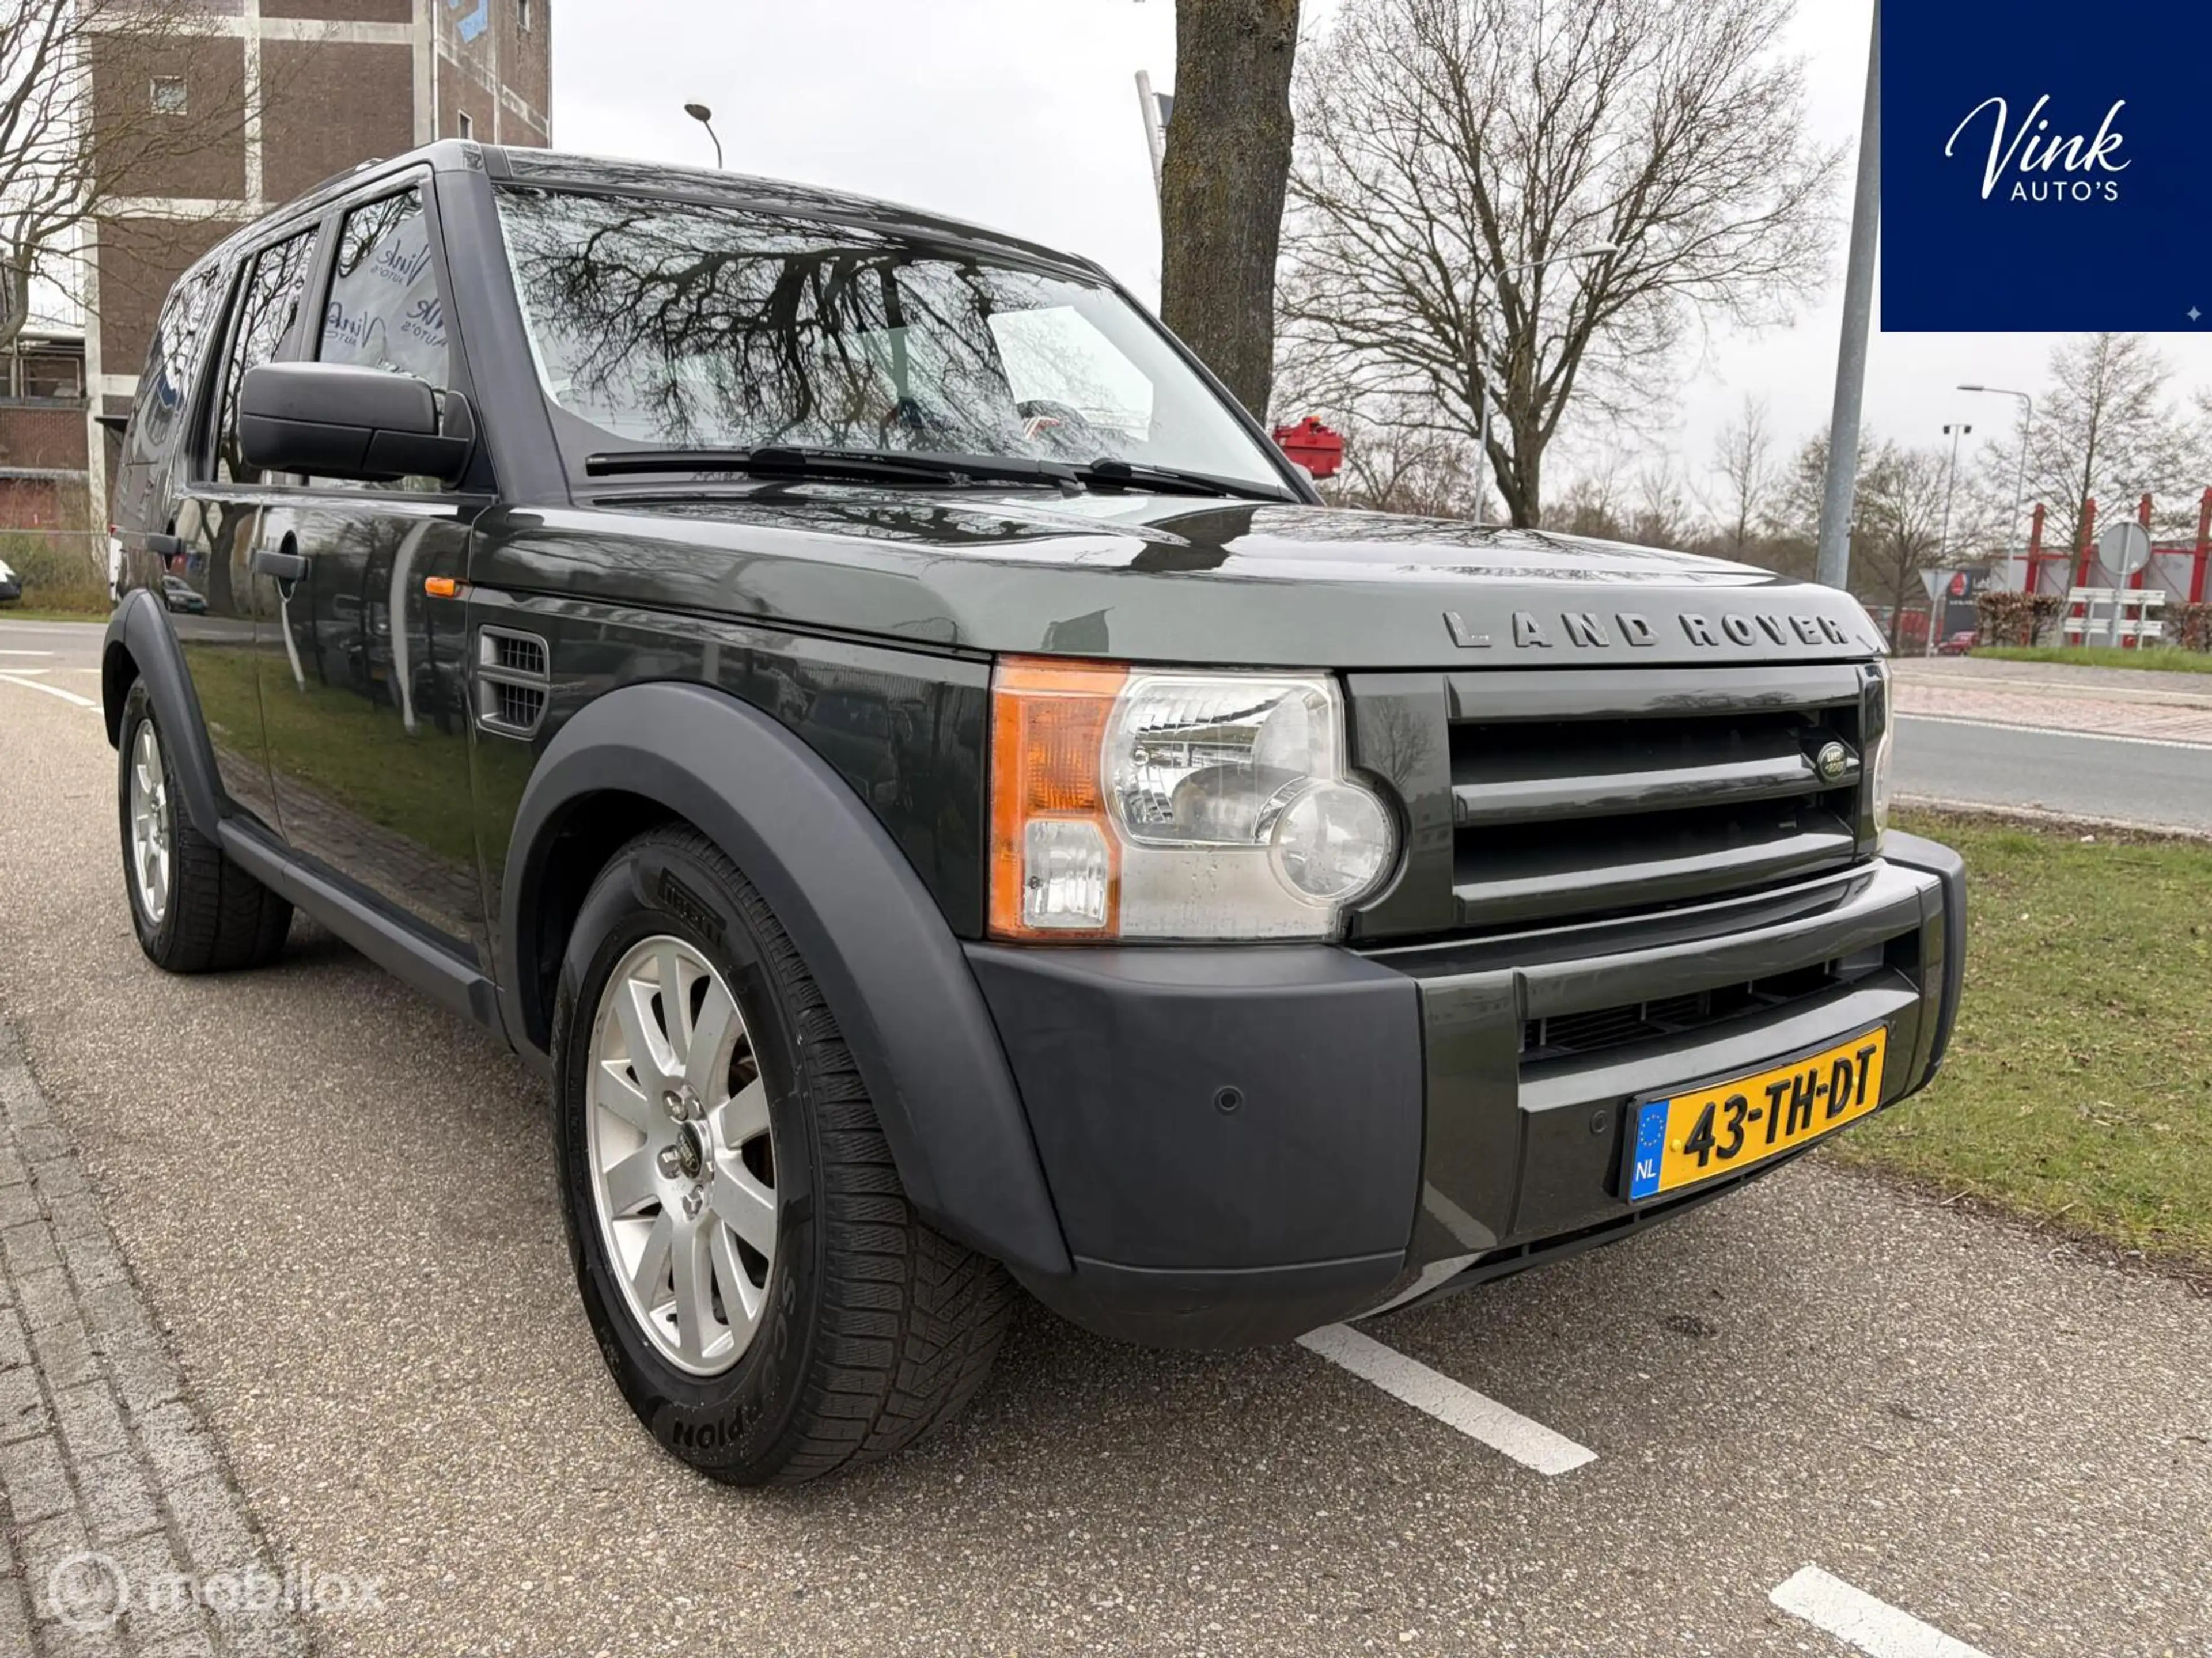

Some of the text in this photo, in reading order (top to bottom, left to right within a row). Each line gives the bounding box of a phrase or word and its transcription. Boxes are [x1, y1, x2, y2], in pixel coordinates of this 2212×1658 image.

[1442, 611, 1850, 648] LAND ROVER
[1683, 1043, 1877, 1167] 43-TH-DT
[1635, 1158, 1657, 1182] NL
